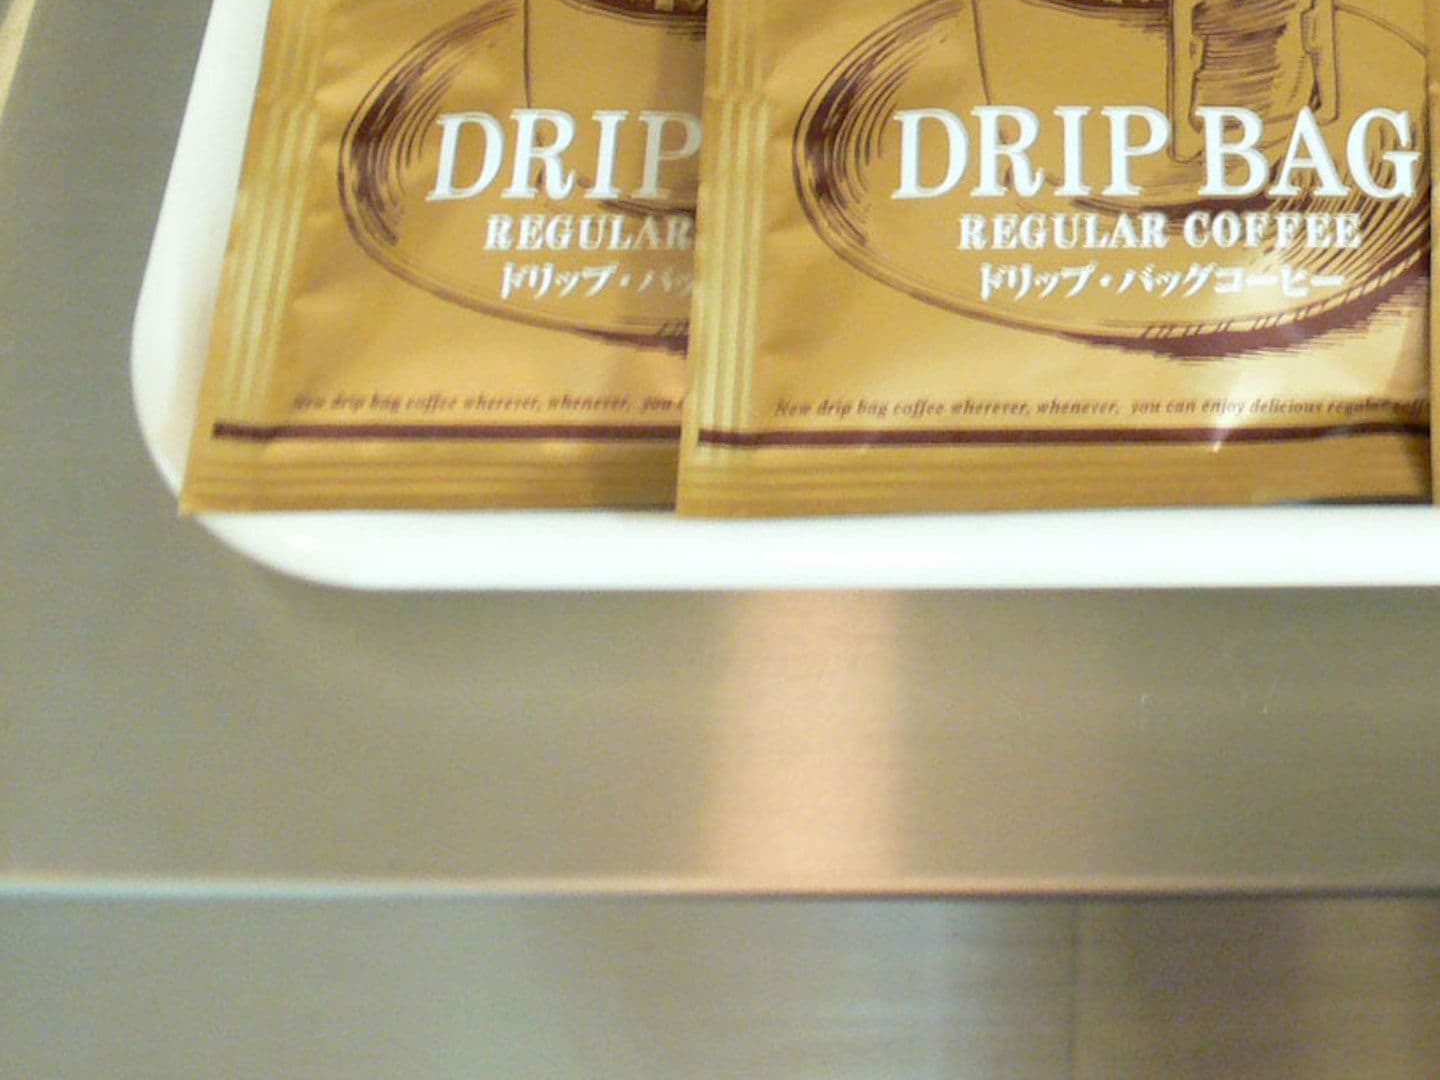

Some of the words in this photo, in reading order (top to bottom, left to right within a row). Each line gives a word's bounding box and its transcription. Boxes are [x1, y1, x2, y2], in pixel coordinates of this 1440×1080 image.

[425, 107, 702, 202] DRIP
[890, 104, 1172, 201] DRIP
[1194, 104, 1424, 200] BAG
[482, 212, 696, 252] REGULAR
[956, 211, 1173, 252] REGULAR
[1182, 210, 1364, 251] COFFEE
[815, 398, 851, 419] drip
[855, 398, 889, 419] bag
[892, 398, 946, 419] coffee
[1130, 400, 1163, 417] you
[1165, 400, 1197, 415] can
[1200, 398, 1246, 418] enjoy
[1249, 397, 1324, 415] delicious
